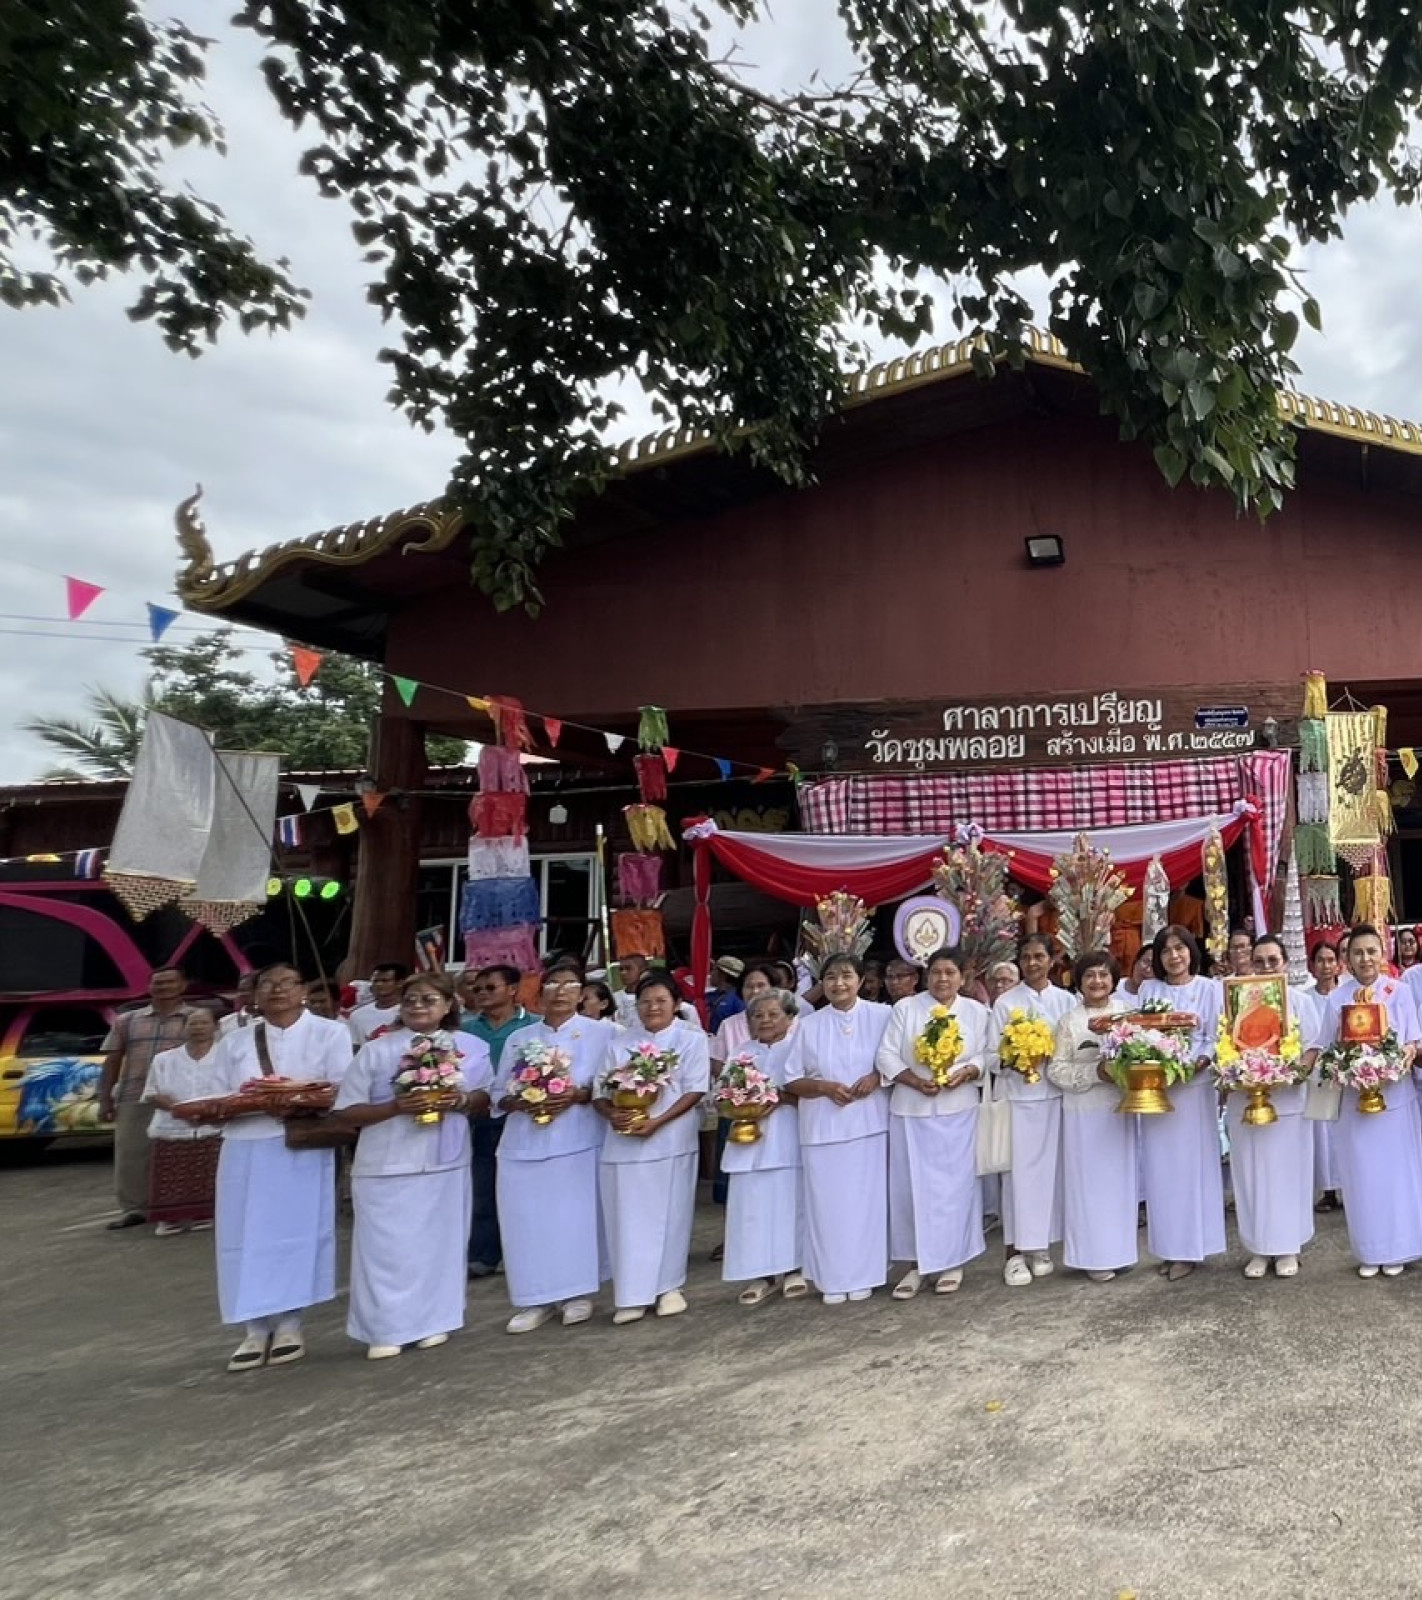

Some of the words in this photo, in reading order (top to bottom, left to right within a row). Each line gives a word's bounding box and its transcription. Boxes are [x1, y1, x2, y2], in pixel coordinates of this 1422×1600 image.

[944, 692, 1161, 731] ศาลาการเปรียญ
[865, 729, 1025, 769] วัดชุมพลอย
[1047, 729, 1135, 756] สร้างเมื่อ
[1142, 729, 1256, 751] พ.ศ.๒๕๕๗
